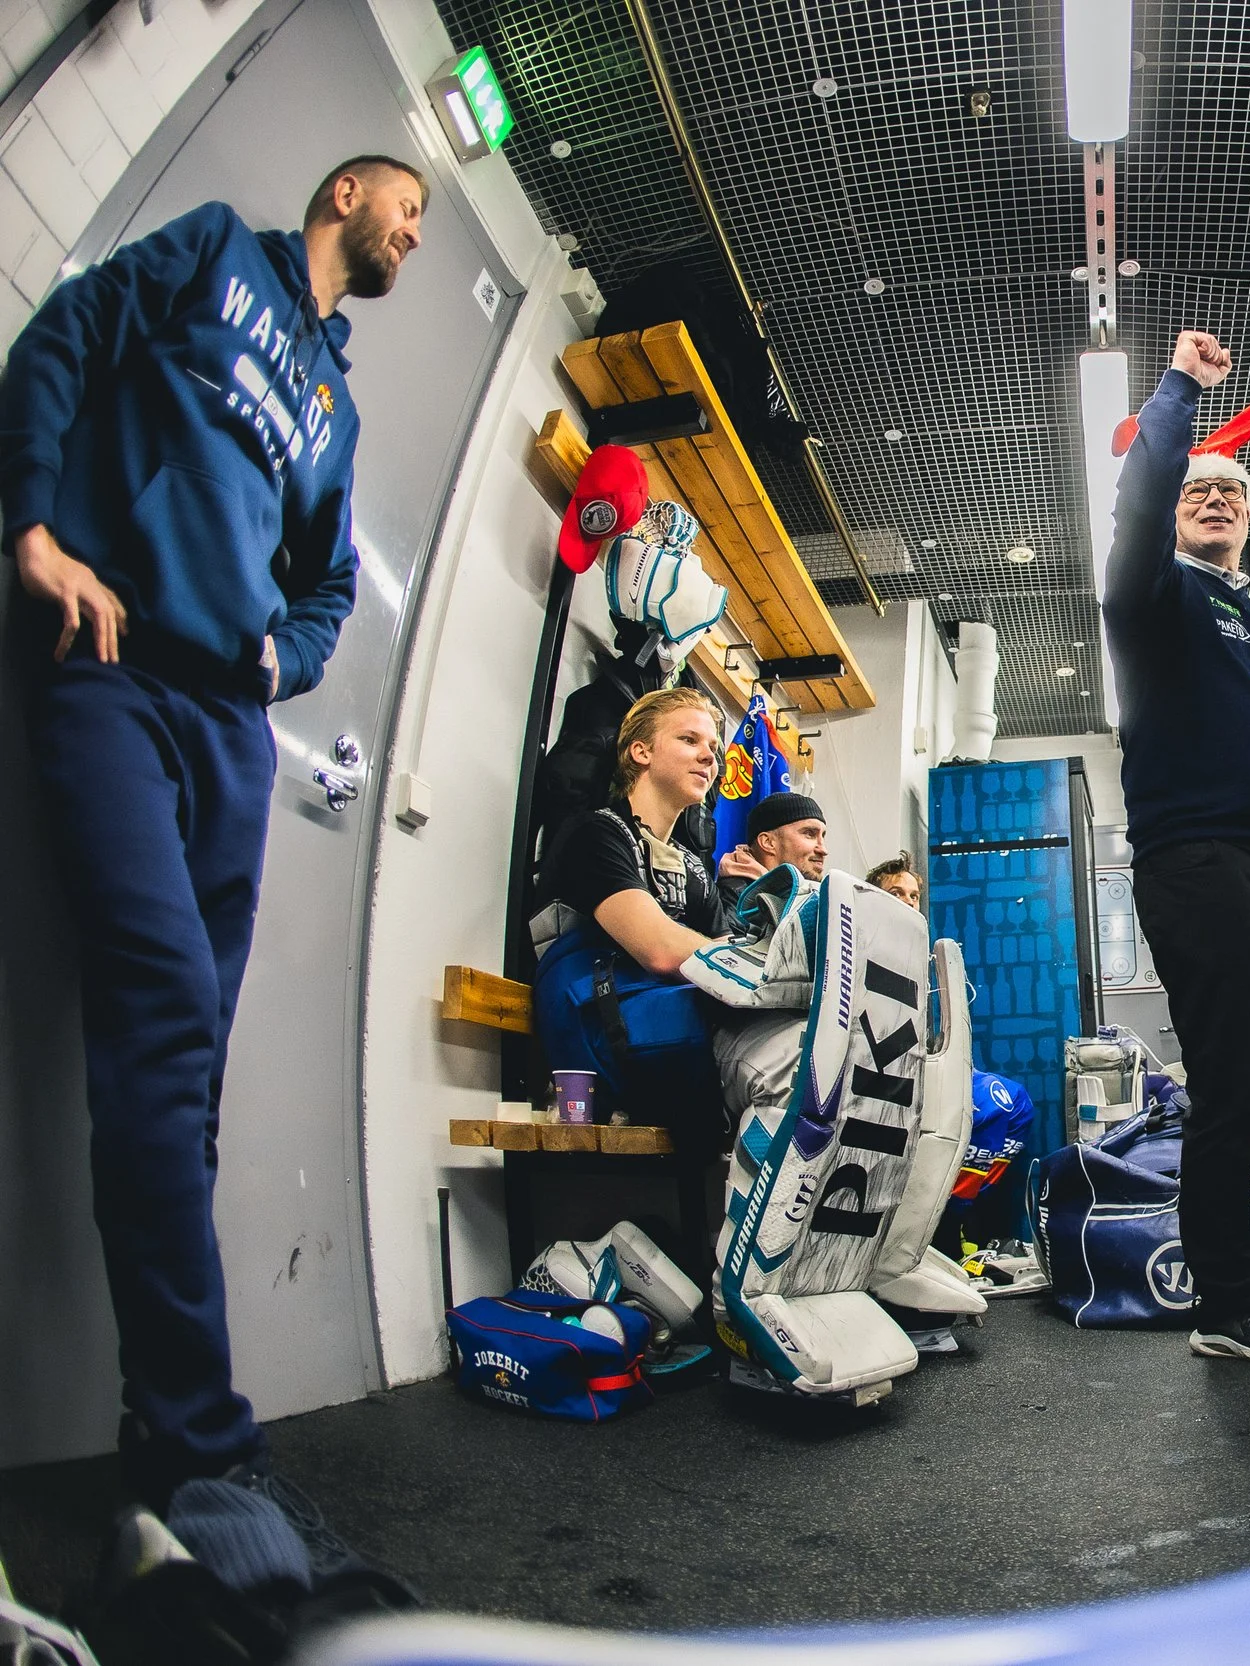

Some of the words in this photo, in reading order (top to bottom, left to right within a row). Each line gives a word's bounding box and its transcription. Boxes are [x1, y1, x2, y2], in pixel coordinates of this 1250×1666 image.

[838, 903, 853, 1031] WARRIOR
[730, 1160, 774, 1277] WARRIOR
[474, 1350, 530, 1381] JOKERIT
[481, 1384, 530, 1408] HOCKEY
